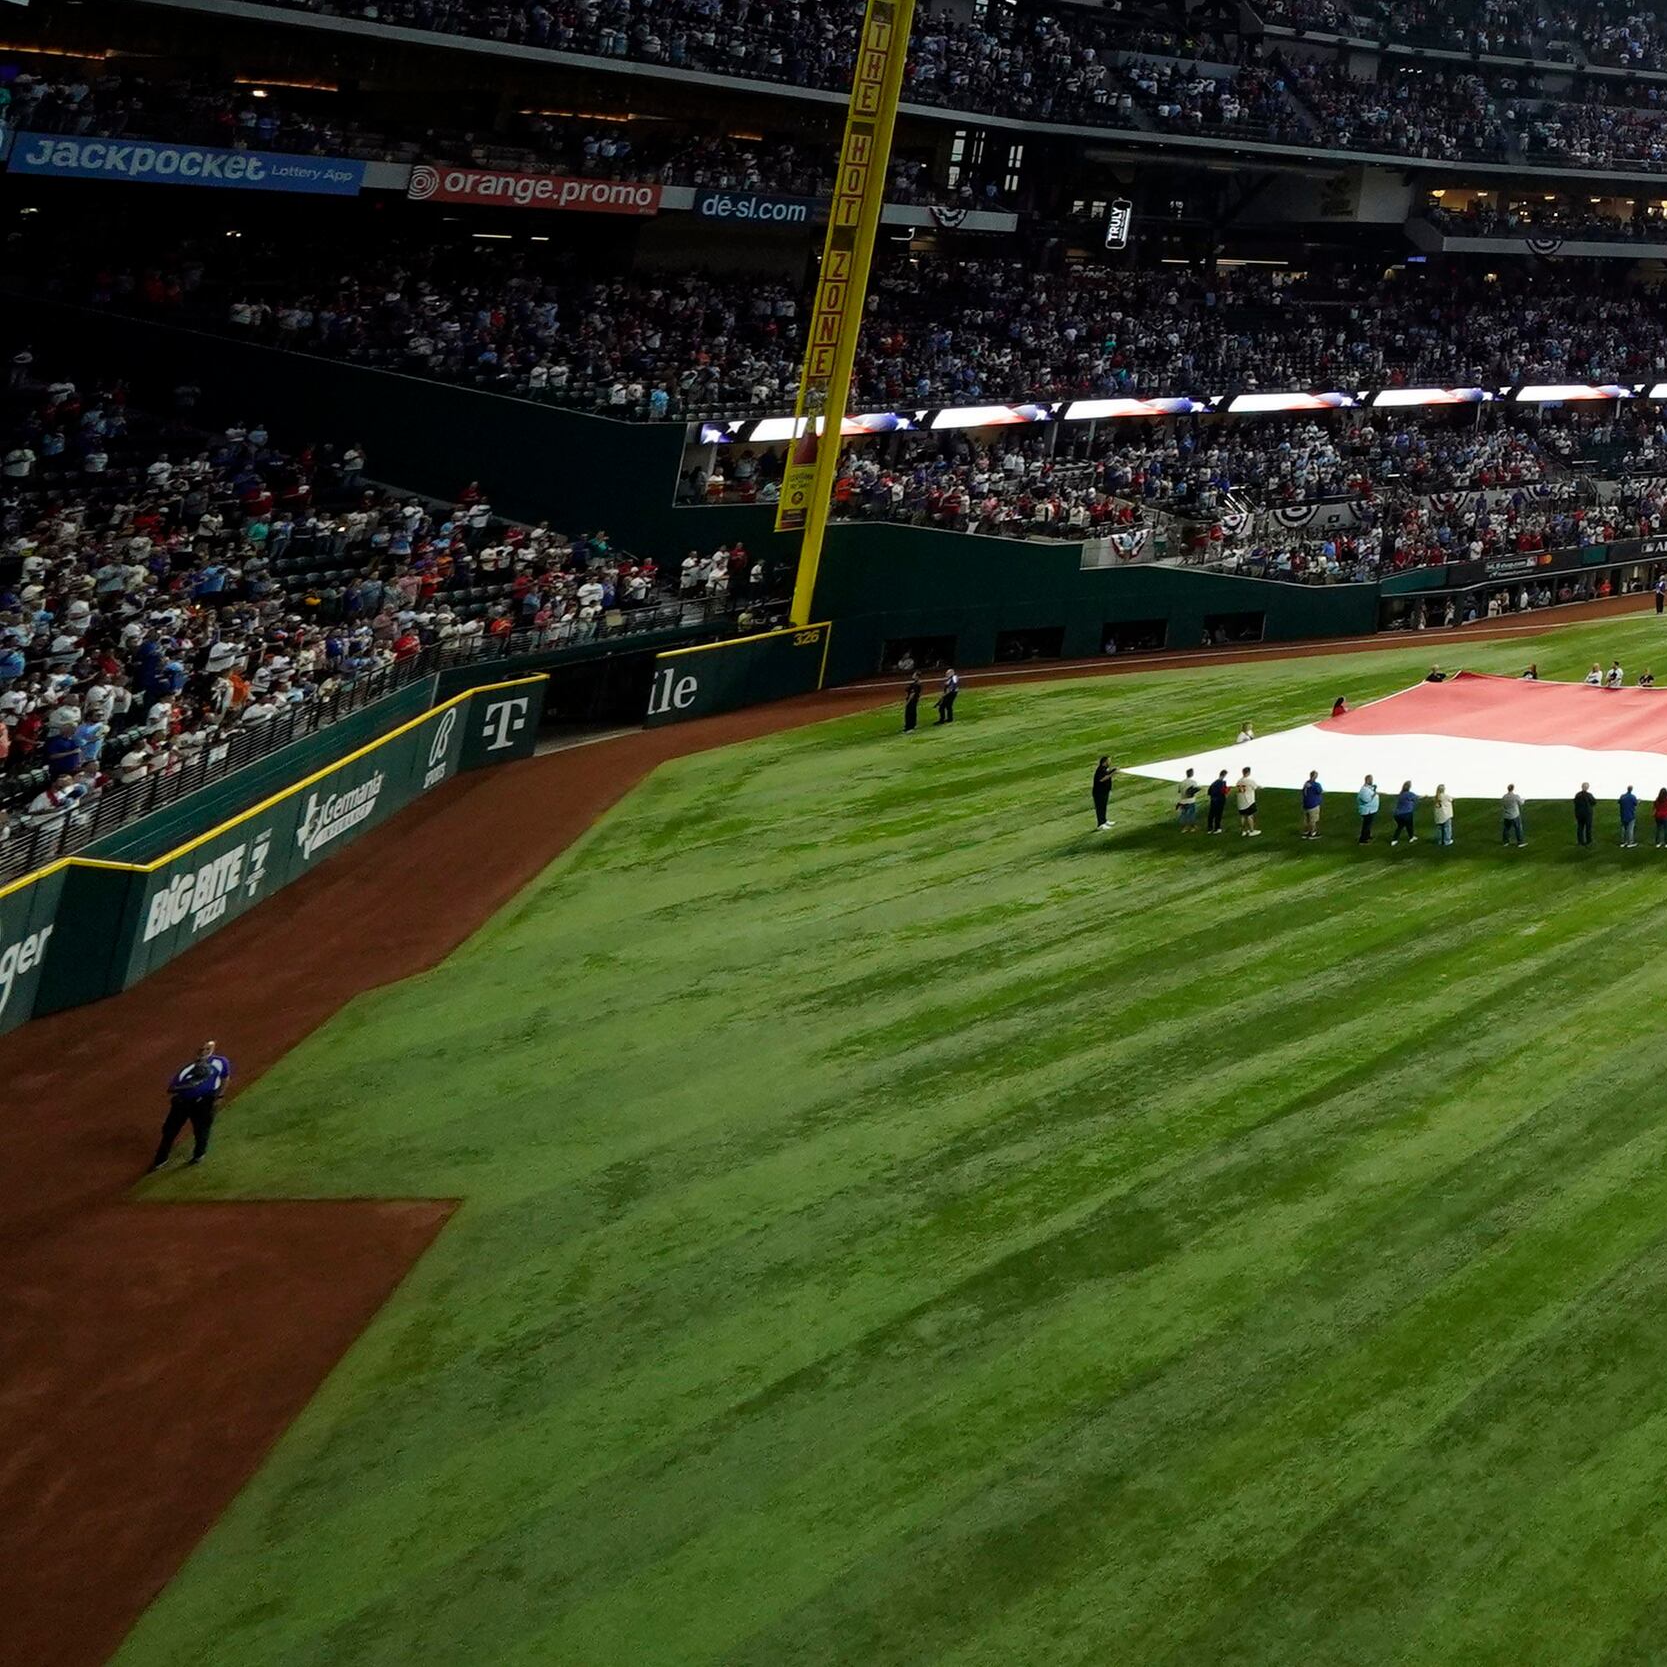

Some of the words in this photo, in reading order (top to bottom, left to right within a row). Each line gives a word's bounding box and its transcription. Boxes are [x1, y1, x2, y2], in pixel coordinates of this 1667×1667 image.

[270, 164, 321, 183] Lottery
[323, 169, 353, 184] App
[443, 171, 654, 207] orange.promo
[837, 135, 872, 226] HOT
[1107, 207, 1123, 240] TRULY
[811, 251, 851, 376] ZONE
[792, 631, 819, 647] 326
[482, 697, 529, 752] T
[323, 770, 385, 825] Germania
[189, 843, 247, 915] BITE
